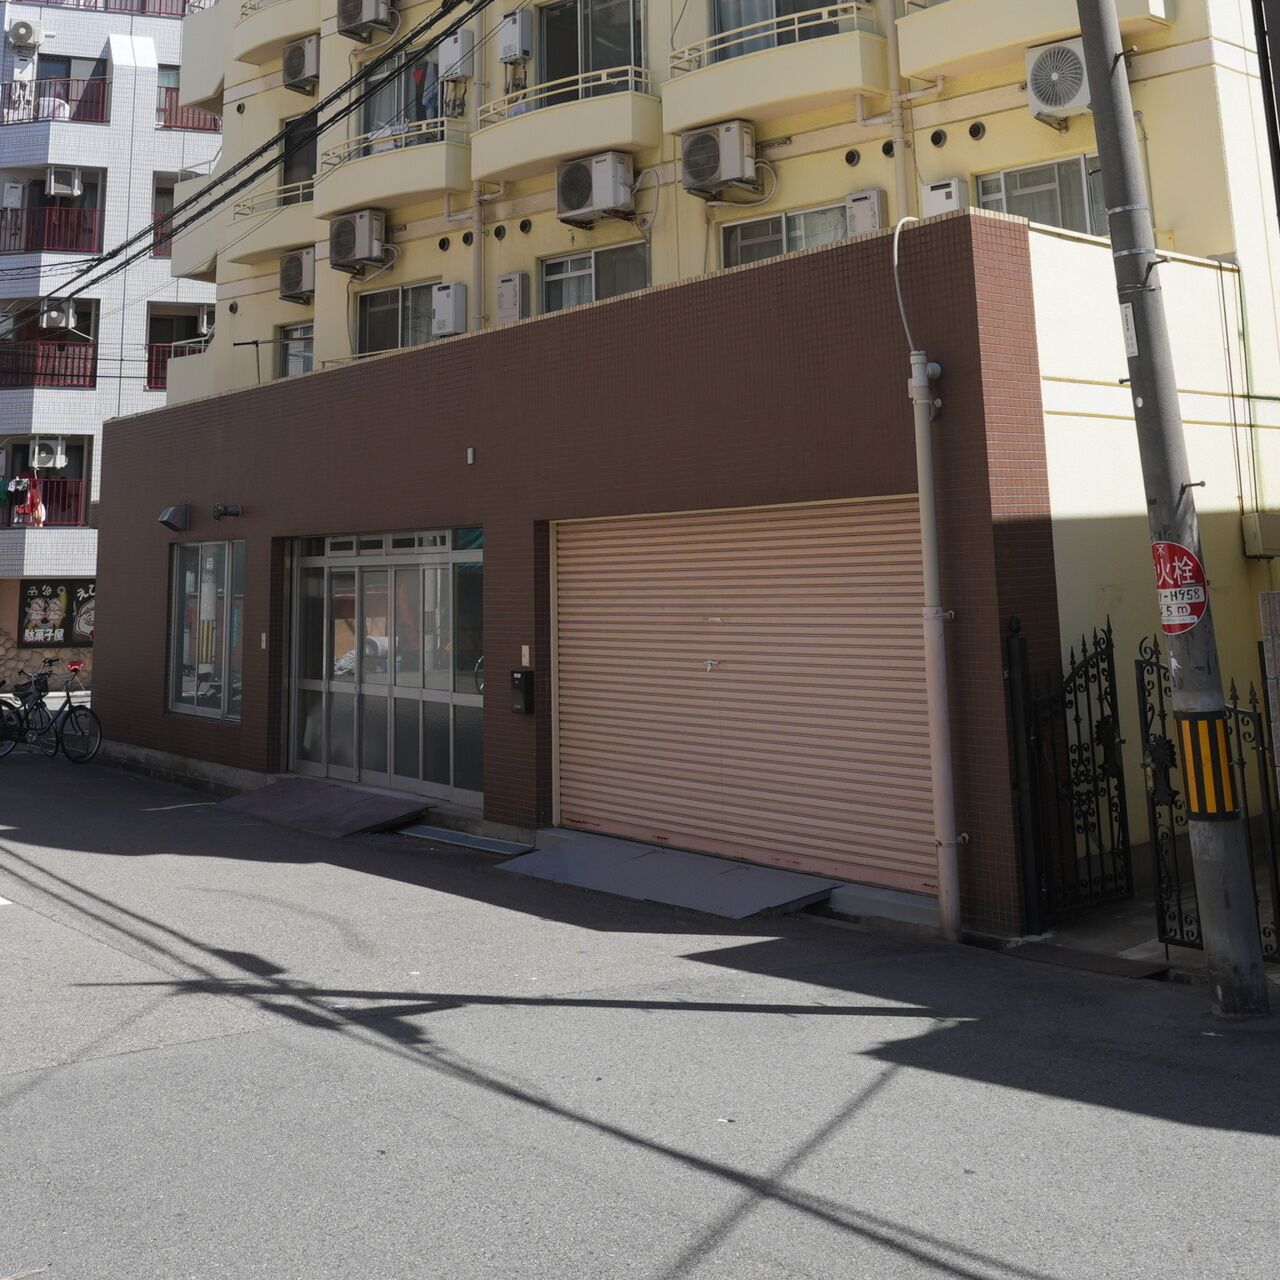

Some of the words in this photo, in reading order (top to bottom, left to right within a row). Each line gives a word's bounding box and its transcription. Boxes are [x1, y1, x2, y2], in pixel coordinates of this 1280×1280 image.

[1154, 555, 1195, 585] 火栓
[24, 628, 65, 642] 駄菓子屋
